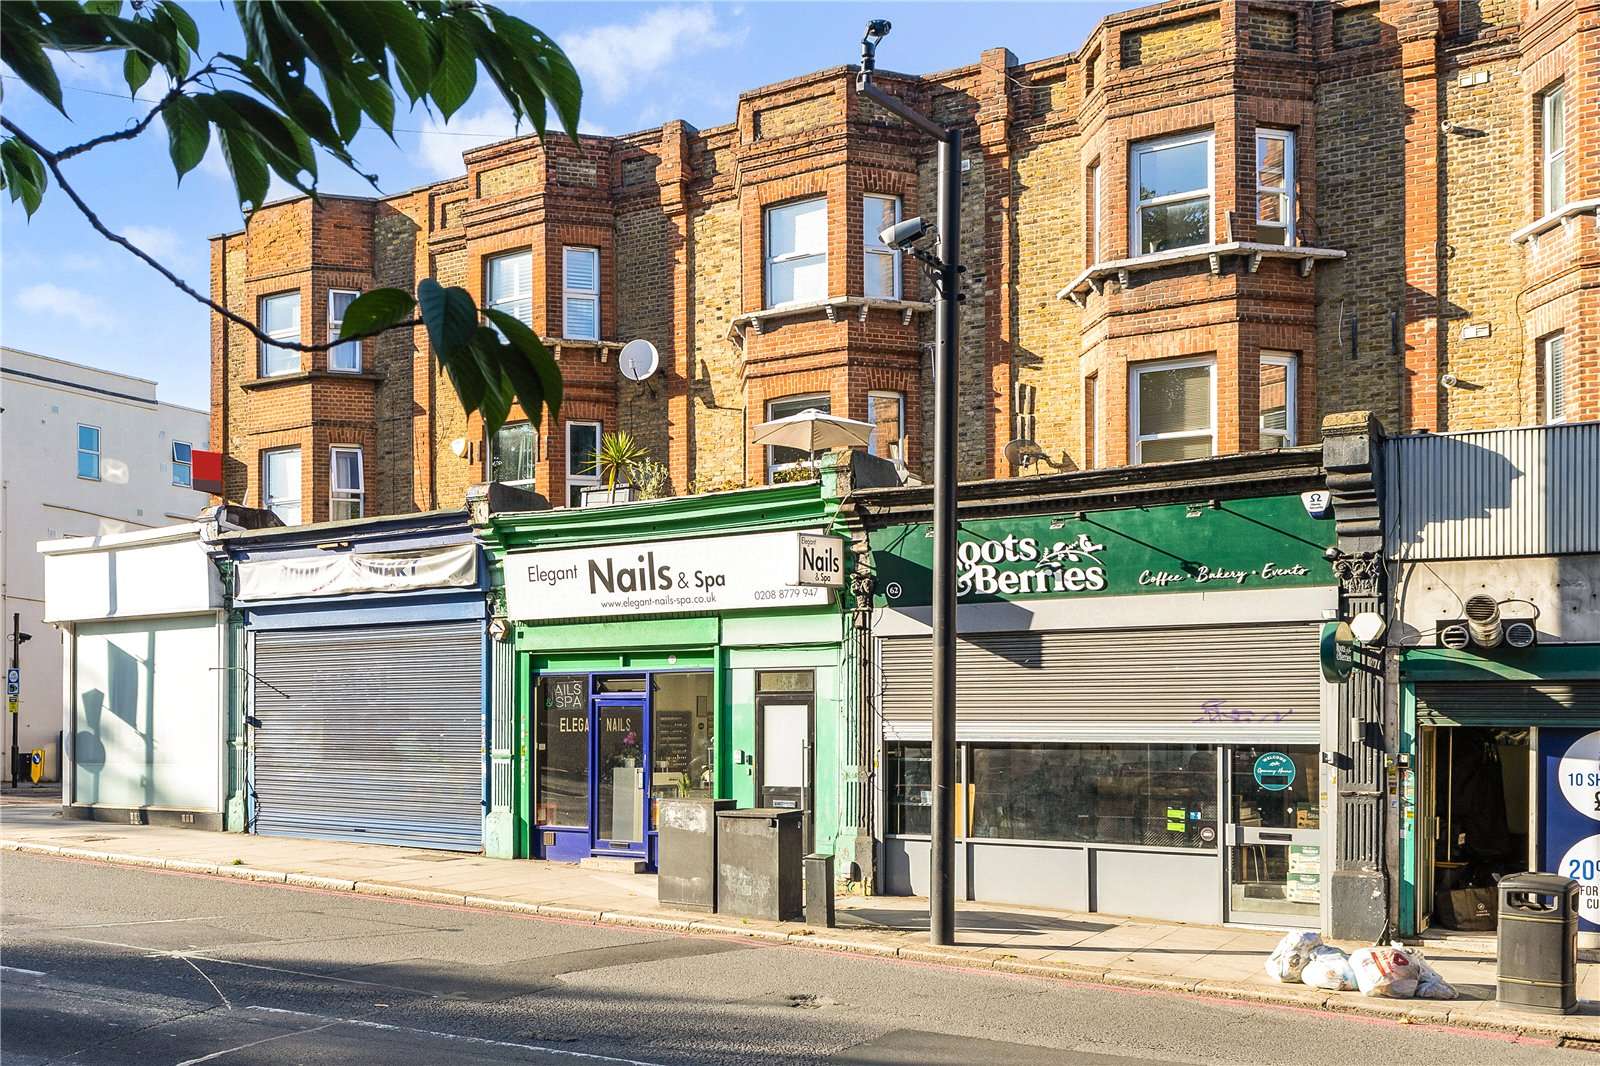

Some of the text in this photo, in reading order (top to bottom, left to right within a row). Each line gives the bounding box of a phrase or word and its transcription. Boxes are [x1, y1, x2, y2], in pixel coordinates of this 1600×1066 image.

[801, 537, 817, 547] Elegant
[957, 533, 1038, 564] oots
[802, 547, 840, 573] Nails
[528, 551, 726, 594] Elegant Nails & Spa
[814, 573, 831, 584] & Spa
[975, 564, 1105, 594] Berries
[1138, 562, 1310, 586] Coffee Bakery Events
[754, 590, 777, 600] 0208
[779, 588, 801, 599] 8779
[889, 586, 899, 594] 62
[601, 592, 717, 609] www.elegant-nails-spa.co.uk
[555, 683, 582, 695] AILS
[555, 695, 582, 708] SPA
[560, 717, 632, 732] ELEGA NAILS
[1568, 773, 1583, 786] 10
[1579, 885, 1599, 896] FOR
[1586, 898, 1600, 910] CU
